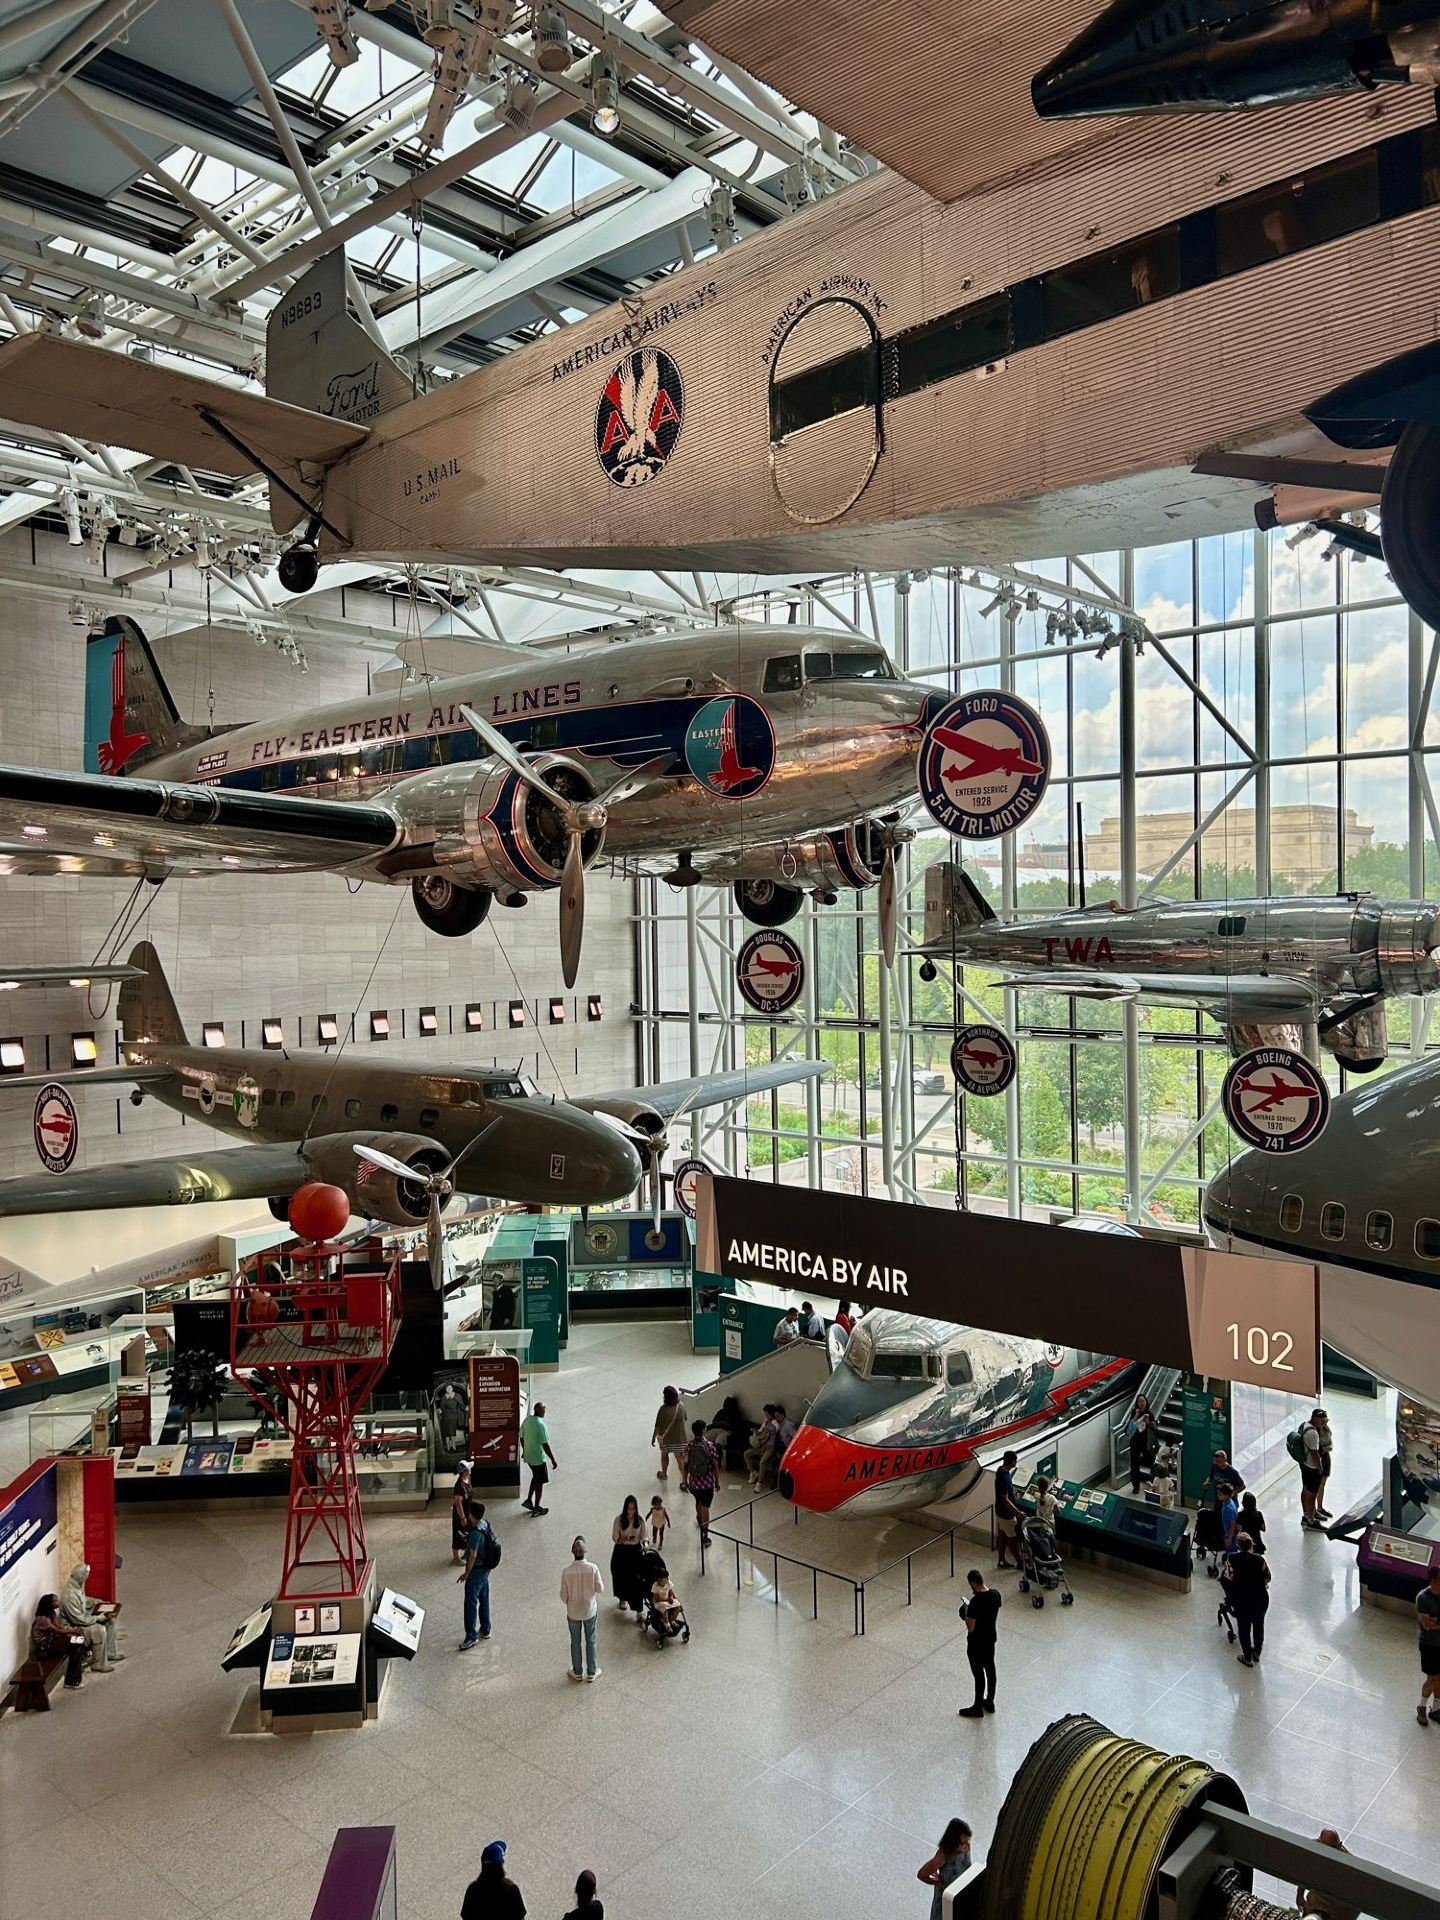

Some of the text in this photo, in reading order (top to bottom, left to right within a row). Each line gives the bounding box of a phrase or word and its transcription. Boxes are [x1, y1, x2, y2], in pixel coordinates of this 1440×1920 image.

[762, 287, 812, 364] AMERICAN
[552, 323, 632, 382] AMERICAN
[318, 360, 380, 417] Ford
[428, 458, 461, 486] MAIL
[965, 698, 998, 716] FORD
[251, 736, 288, 760] FLY
[300, 712, 411, 751] EASTERN
[493, 680, 582, 716] LINES
[692, 727, 732, 739] EASTERN
[955, 785, 1009, 797] ENTERED SERVICE
[972, 797, 992, 807] 1928
[930, 787, 1038, 835] 5-AT TRI-MOTOR
[754, 932, 785, 945] DOUGLAS
[1041, 936, 1115, 964] TWA
[760, 1000, 780, 1011] DC-3
[966, 1027, 999, 1040] NORTHROP
[1255, 1052, 1292, 1066] BOEING
[976, 1082, 1000, 1094] ALPHA
[1267, 1121, 1283, 1131] 1970
[1276, 1115, 1297, 1123] SERVICE
[1265, 1136, 1284, 1150] 747
[688, 1209, 696, 1218] 24
[139, 1251, 212, 1283] AMERICAN AIRWAYS
[728, 1238, 909, 1297] AMERICA BY AIR
[722, 1317, 744, 1330] ENTRANCE
[1226, 1323, 1294, 1372] 102
[844, 1449, 949, 1482] AMERICAN
